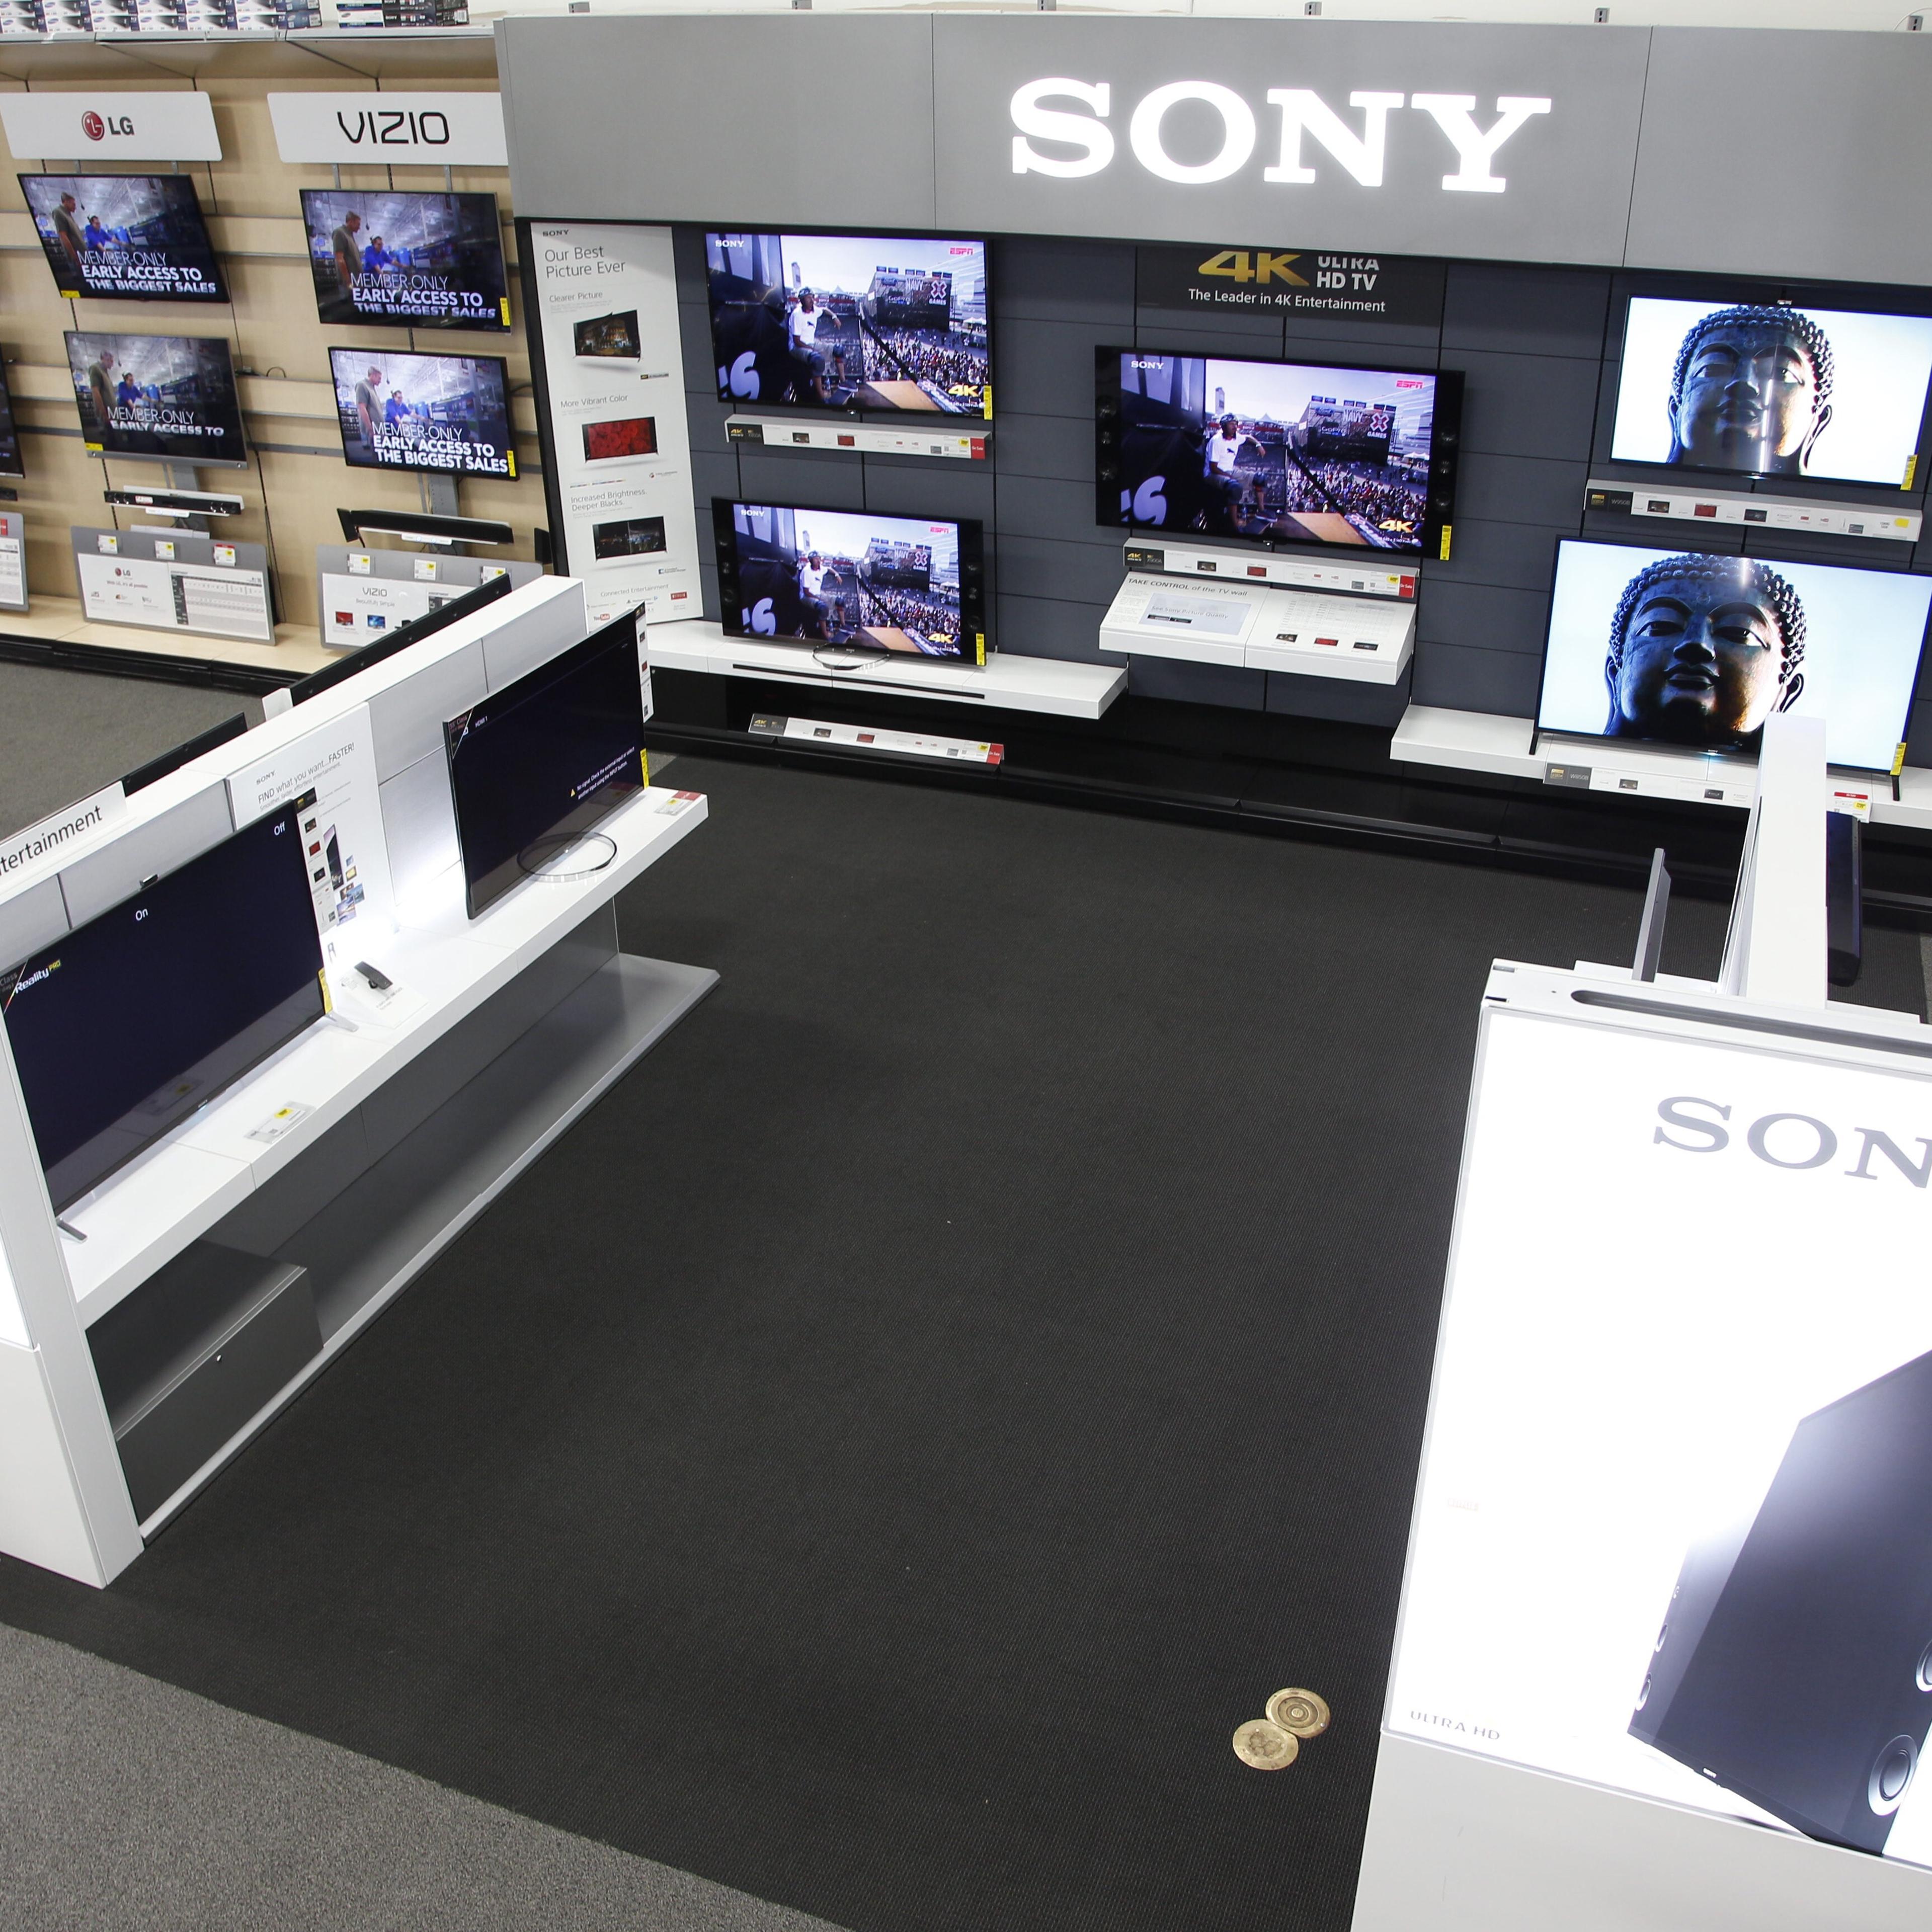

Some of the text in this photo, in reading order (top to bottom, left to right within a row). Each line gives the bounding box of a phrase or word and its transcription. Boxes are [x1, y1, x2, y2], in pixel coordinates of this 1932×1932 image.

[108, 116, 134, 136] LG
[337, 111, 450, 144] VIZIO
[1010, 77, 1552, 193] SONY
[76, 251, 166, 266] MEMBER-ONLY
[545, 246, 604, 262] Our Best
[82, 265, 202, 281] EARLY ACCESS TO
[546, 261, 625, 278] Picture Ever
[1198, 251, 1309, 286] 4K
[86, 279, 216, 293] THE BIGGEST SALES
[351, 273, 448, 290] MEMBER-ONLY
[906, 278, 923, 291] NAVY
[1316, 271, 1377, 291] HD TV
[352, 288, 483, 307] EARLY ACCESS TO
[549, 291, 603, 303] Clearer Picture
[1189, 289, 1386, 312] The Leader in 4K Entertainment
[354, 302, 496, 318] THE BIGGEST SALES
[1131, 361, 1164, 370] SONY
[948, 384, 979, 397] 4K
[1396, 380, 1423, 389] ESPN
[560, 394, 628, 408] More Vibrant Color
[107, 406, 194, 424] MEMBER-ONLY
[1343, 410, 1363, 423] NAVY
[110, 420, 224, 436] EARLY ACCESS TO
[372, 422, 462, 442] MEMBER-ONLY
[373, 435, 495, 457] EARLY ACCESS TO
[375, 448, 508, 473] THE BIGGEST SALES
[571, 493, 605, 504] Increased
[572, 500, 599, 512] Deeper
[1379, 520, 1413, 533] 4K
[362, 587, 387, 597] VIZIO
[601, 584, 669, 597] Connected Entertainment
[1151, 580, 1189, 590] CONTROL
[928, 633, 952, 643] 4K
[256, 769, 275, 785] SONY
[258, 788, 275, 804] FIND
[276, 777, 293, 794] what
[294, 771, 306, 783] you
[274, 821, 286, 836] Off
[135, 908, 148, 921] On
[15, 968, 49, 994] Reality
[49, 959, 61, 972] PRO
[1653, 1096, 1932, 1189] SON
[1410, 1710, 1500, 1740] ULTRA HD
